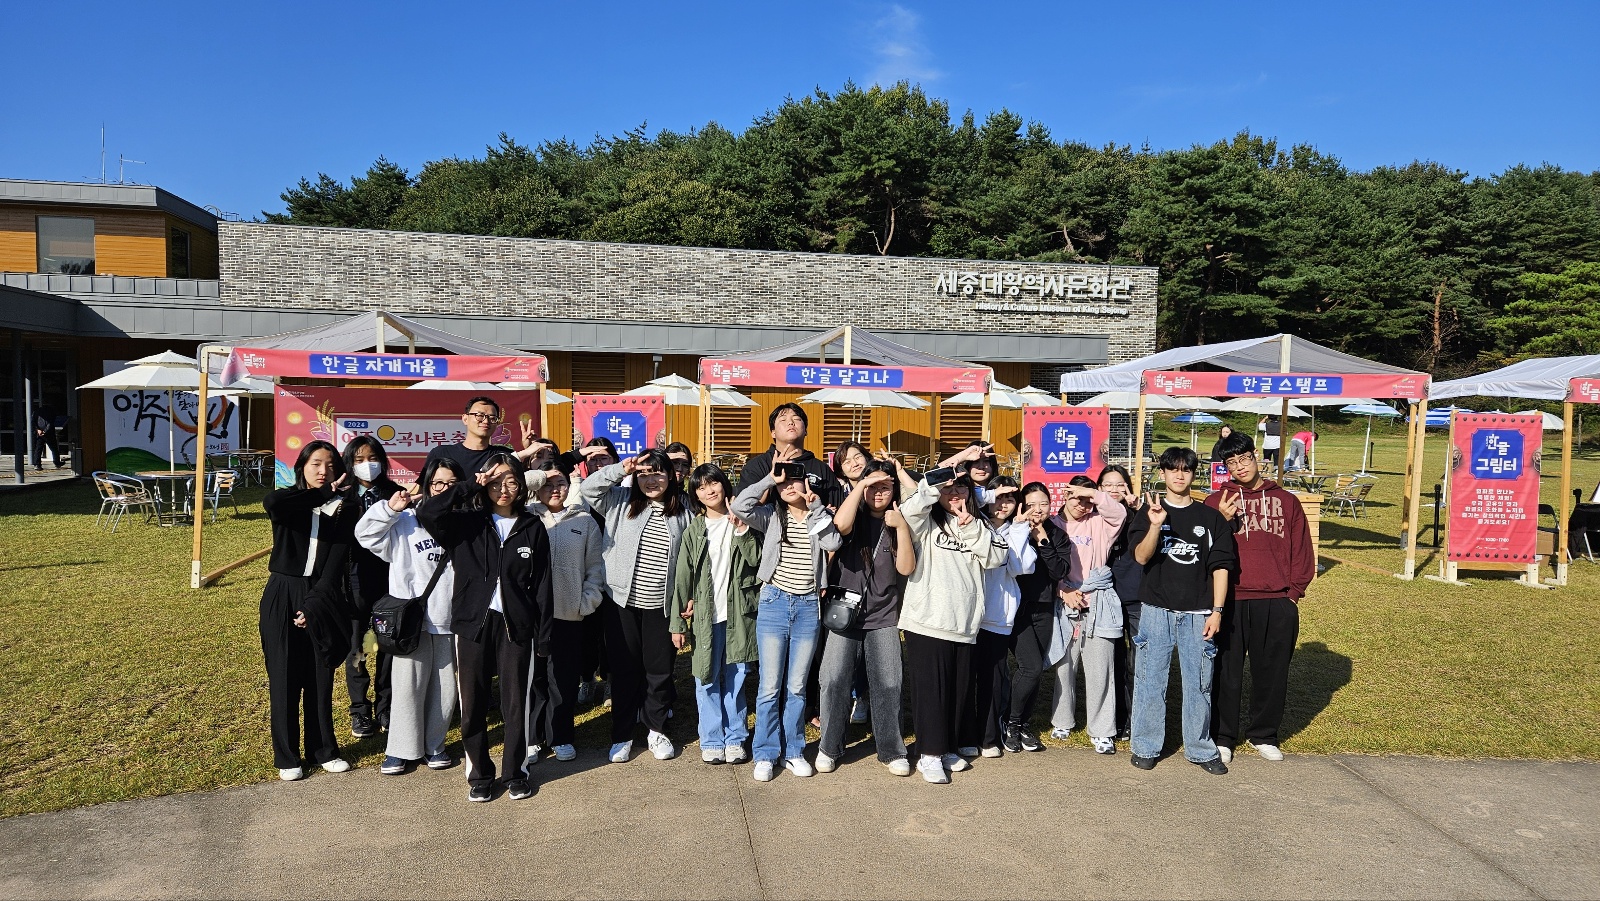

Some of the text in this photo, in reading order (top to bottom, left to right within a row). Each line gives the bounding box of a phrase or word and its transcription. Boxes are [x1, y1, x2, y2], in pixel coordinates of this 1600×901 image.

[934, 270, 1133, 299] 세종대왕역사문화관
[976, 302, 1002, 310] History
[1011, 303, 1039, 311] Culture
[1040, 304, 1071, 312] Museum
[1082, 305, 1100, 314] King
[1101, 306, 1129, 315] Sejong
[322, 355, 360, 374] 한글
[801, 367, 890, 386] 한글 달고나
[1242, 376, 1328, 394] 한글 스탬프
[610, 415, 632, 438] 한글
[1056, 426, 1079, 449] 한글
[1487, 433, 1511, 456] 한글
[614, 440, 643, 455] 고나
[1045, 450, 1087, 467] 스탬프
[1475, 457, 1517, 474] 그림터
[1233, 496, 1284, 518] UTER
